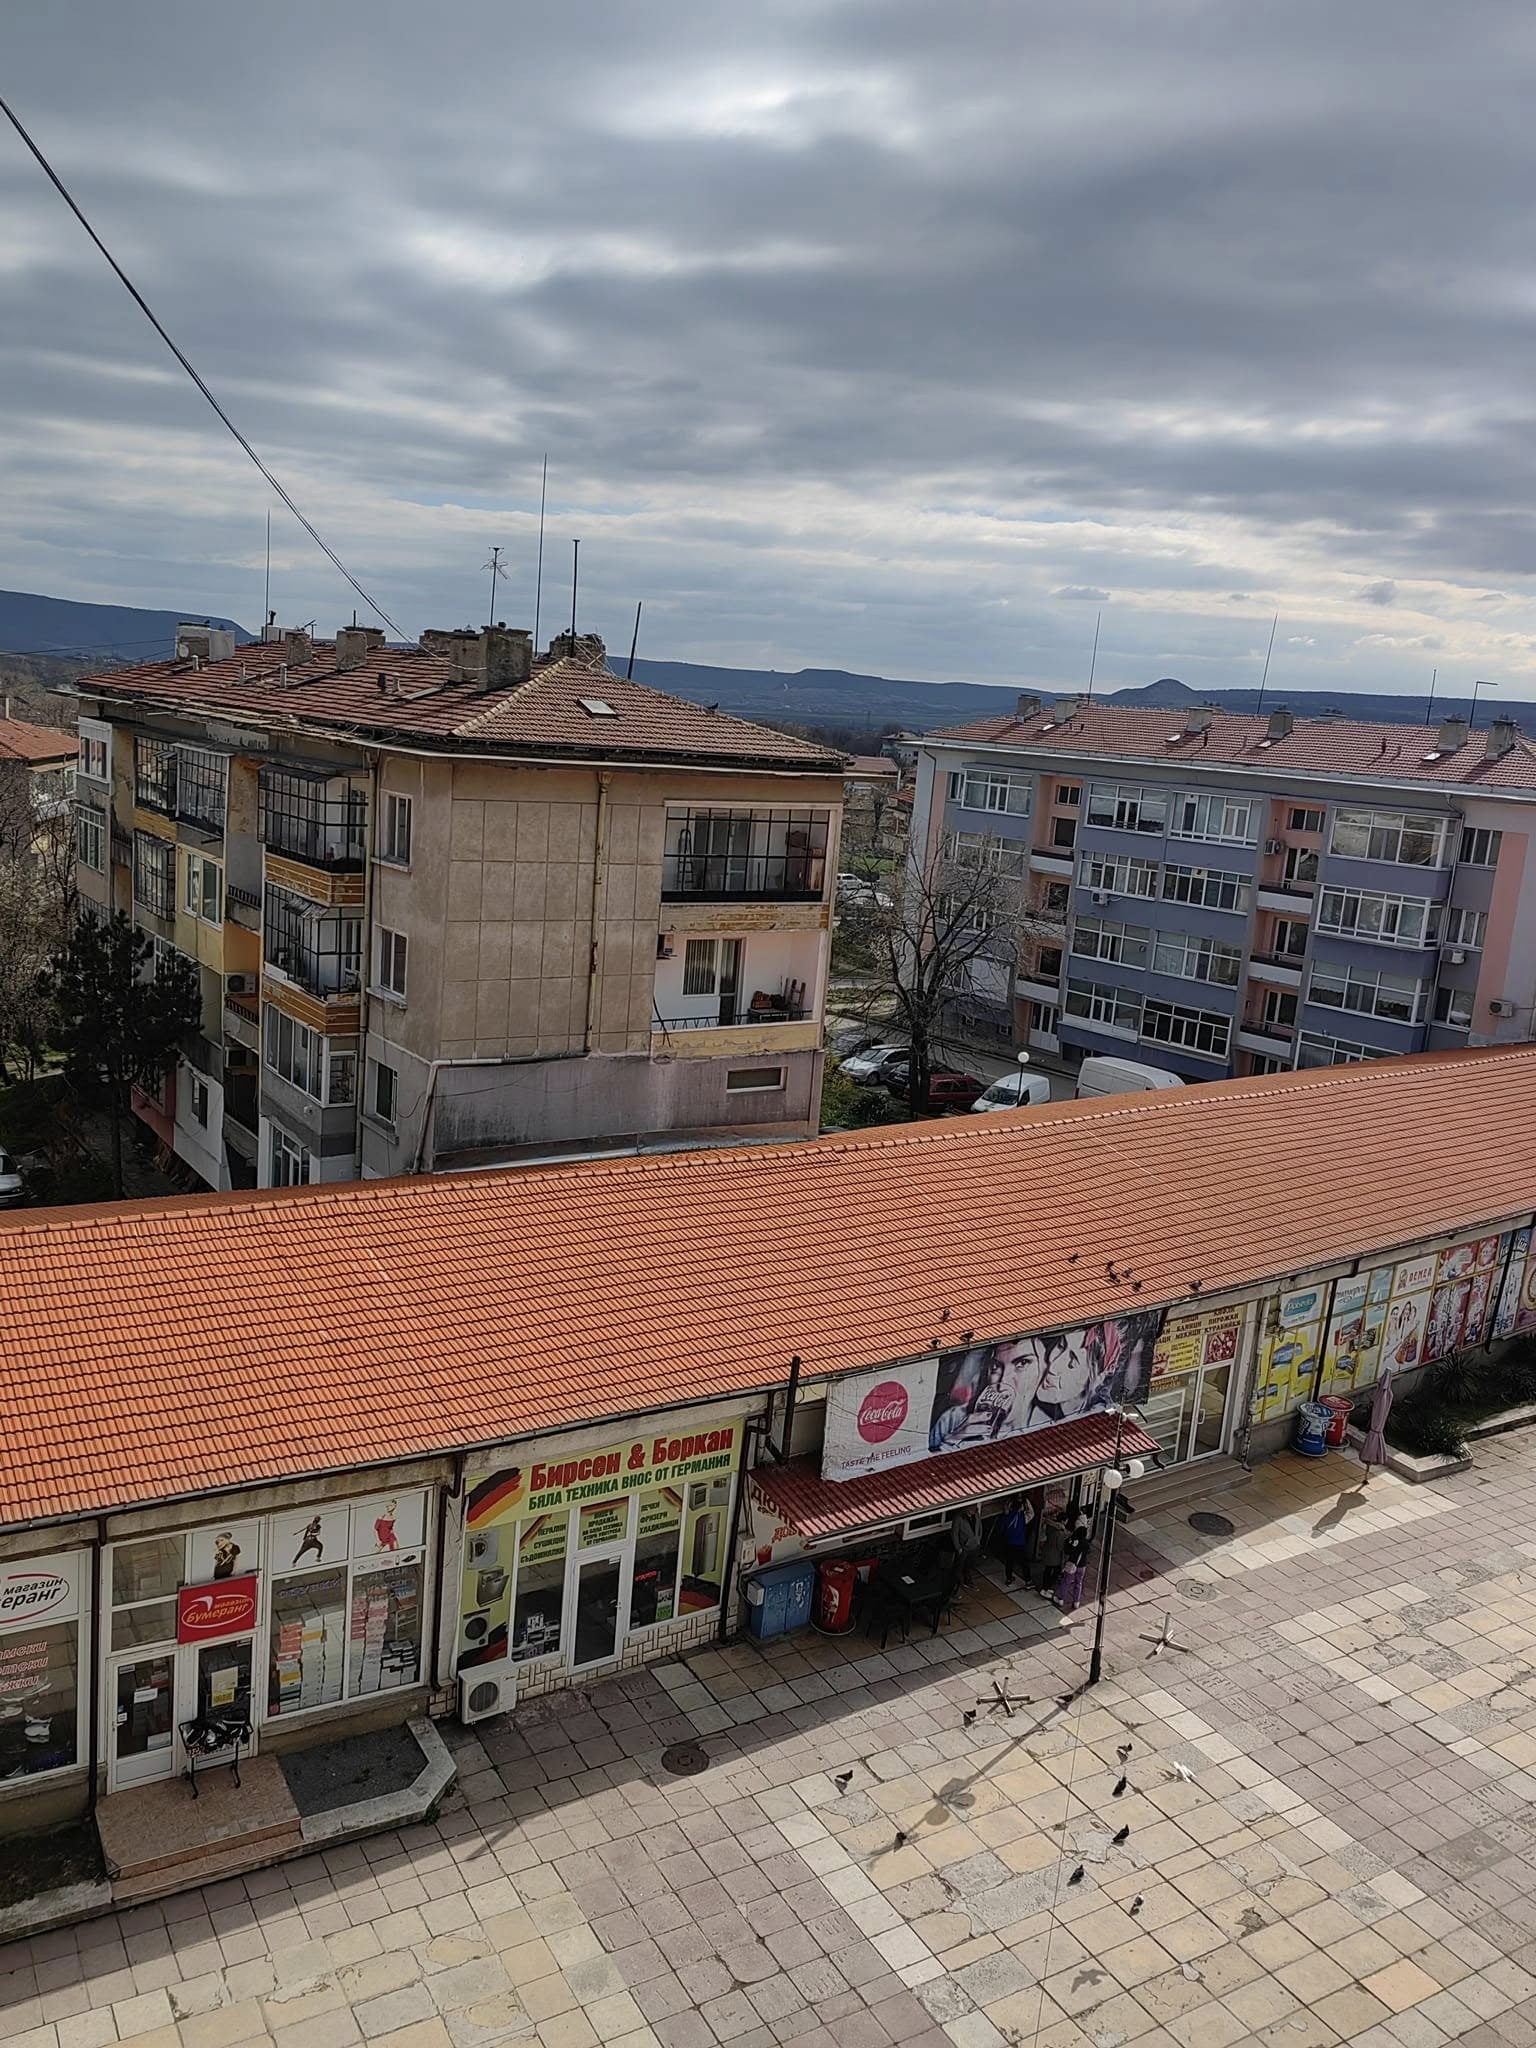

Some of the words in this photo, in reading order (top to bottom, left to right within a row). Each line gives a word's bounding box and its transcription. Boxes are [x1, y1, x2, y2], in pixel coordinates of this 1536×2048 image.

[530, 1452, 621, 1492] Бирсен
[627, 1443, 645, 1470] &
[652, 1428, 734, 1465] Беркан
[842, 1456, 865, 1470] TASTE
[881, 1445, 912, 1461] FEELING
[528, 1493, 562, 1511] БЯЛА
[566, 1481, 619, 1502] ТЕХНИКА
[621, 1470, 652, 1489] ВНОС
[655, 1466, 670, 1483] ОТ
[671, 1453, 731, 1479] ГЕРМАНИЯ
[4, 1578, 64, 1596] магазин
[186, 1603, 249, 1624] Бумеранг
[0, 1657, 49, 1676] тски
